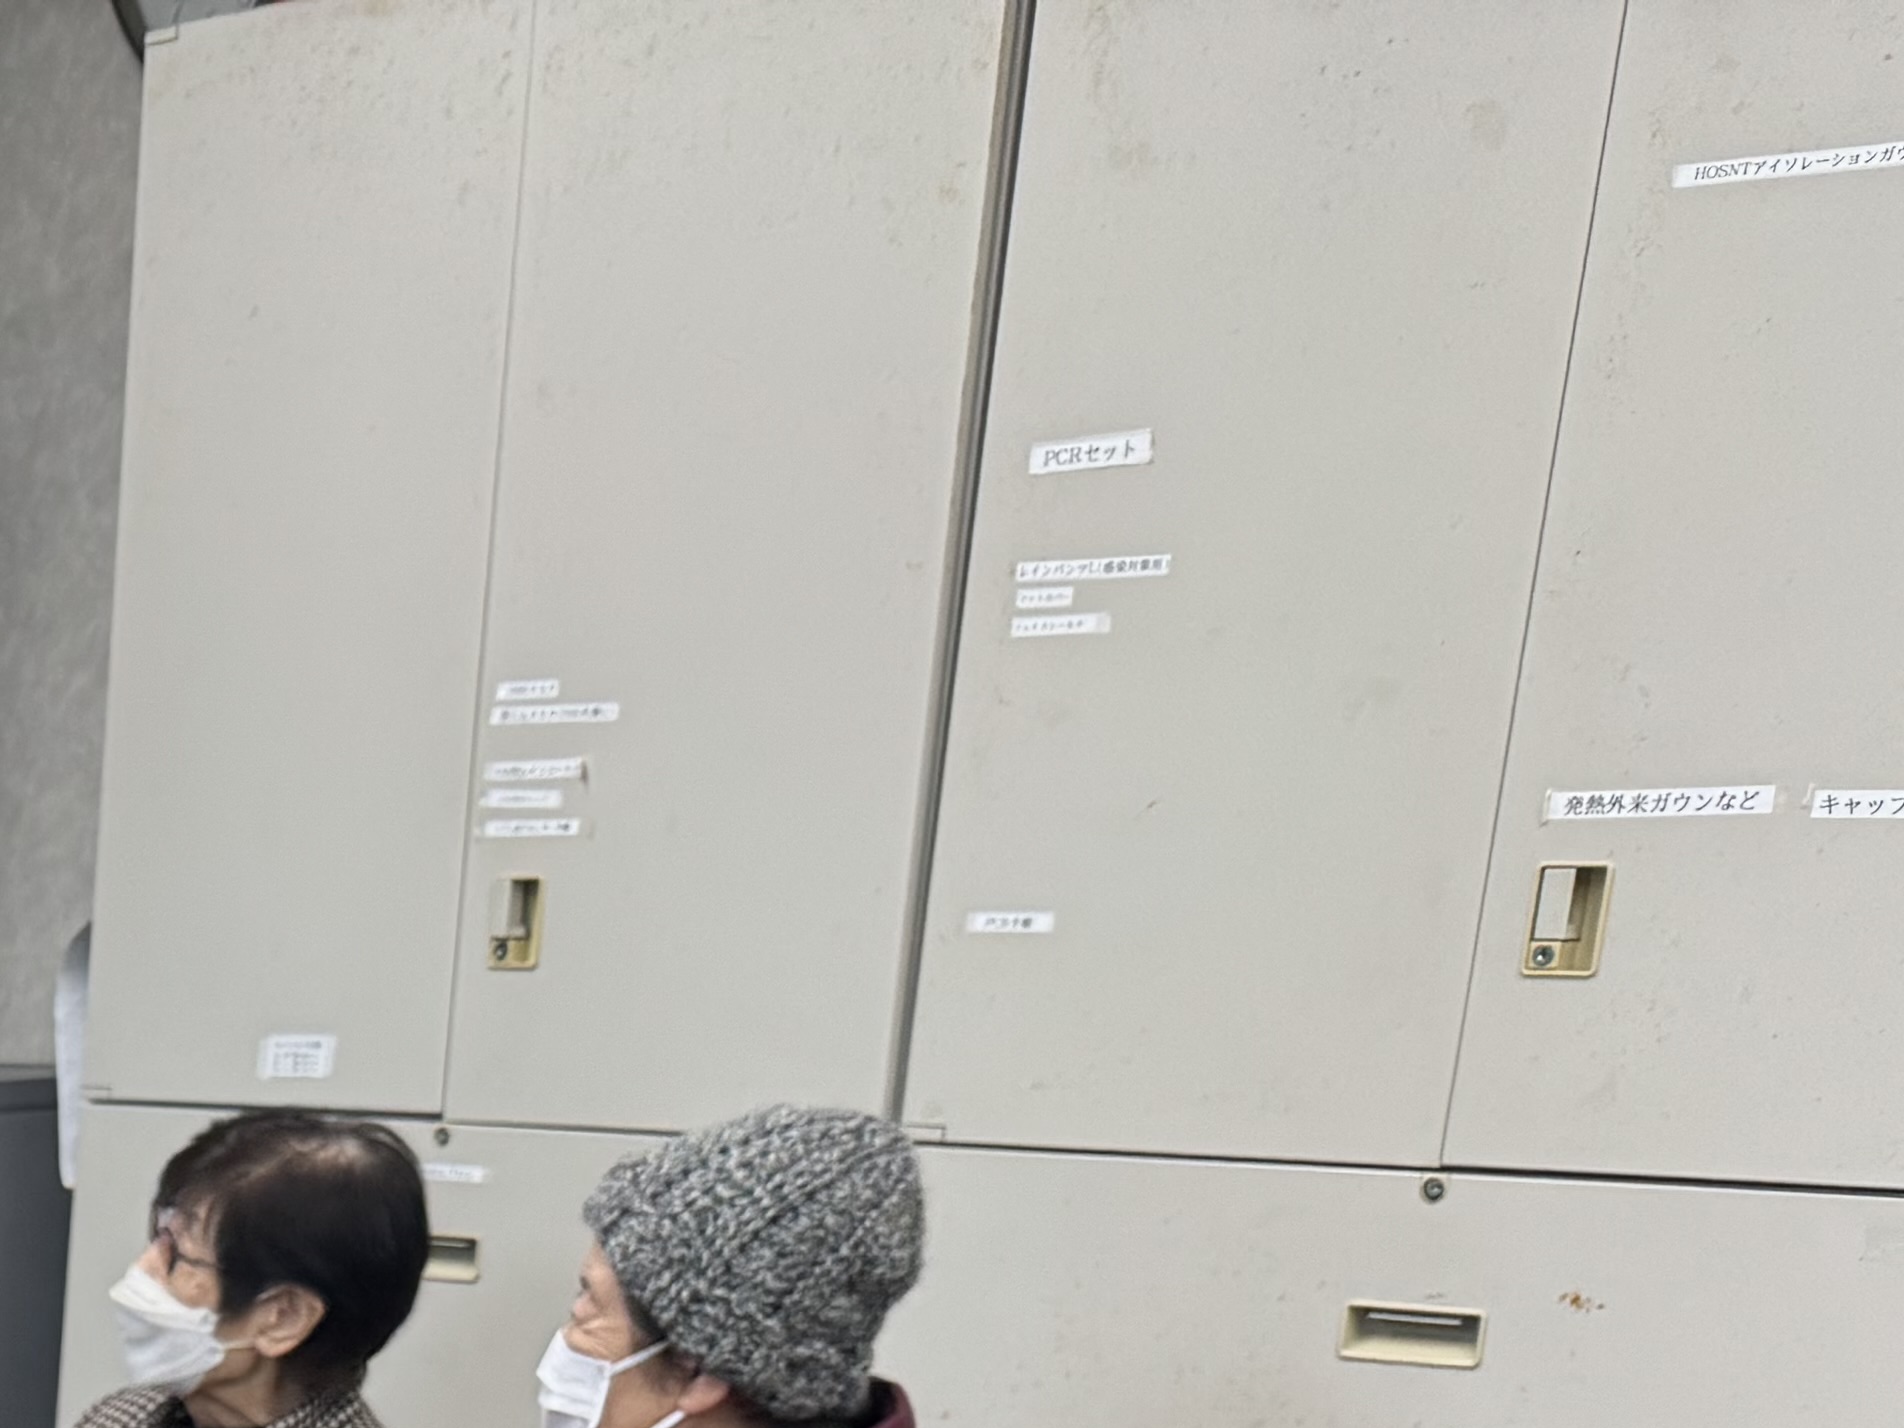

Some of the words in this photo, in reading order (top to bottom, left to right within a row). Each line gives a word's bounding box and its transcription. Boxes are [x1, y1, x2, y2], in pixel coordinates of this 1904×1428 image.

[1042, 439, 1136, 467] PCRセット
[1563, 789, 1761, 817] 発熱外来ガウンなど
